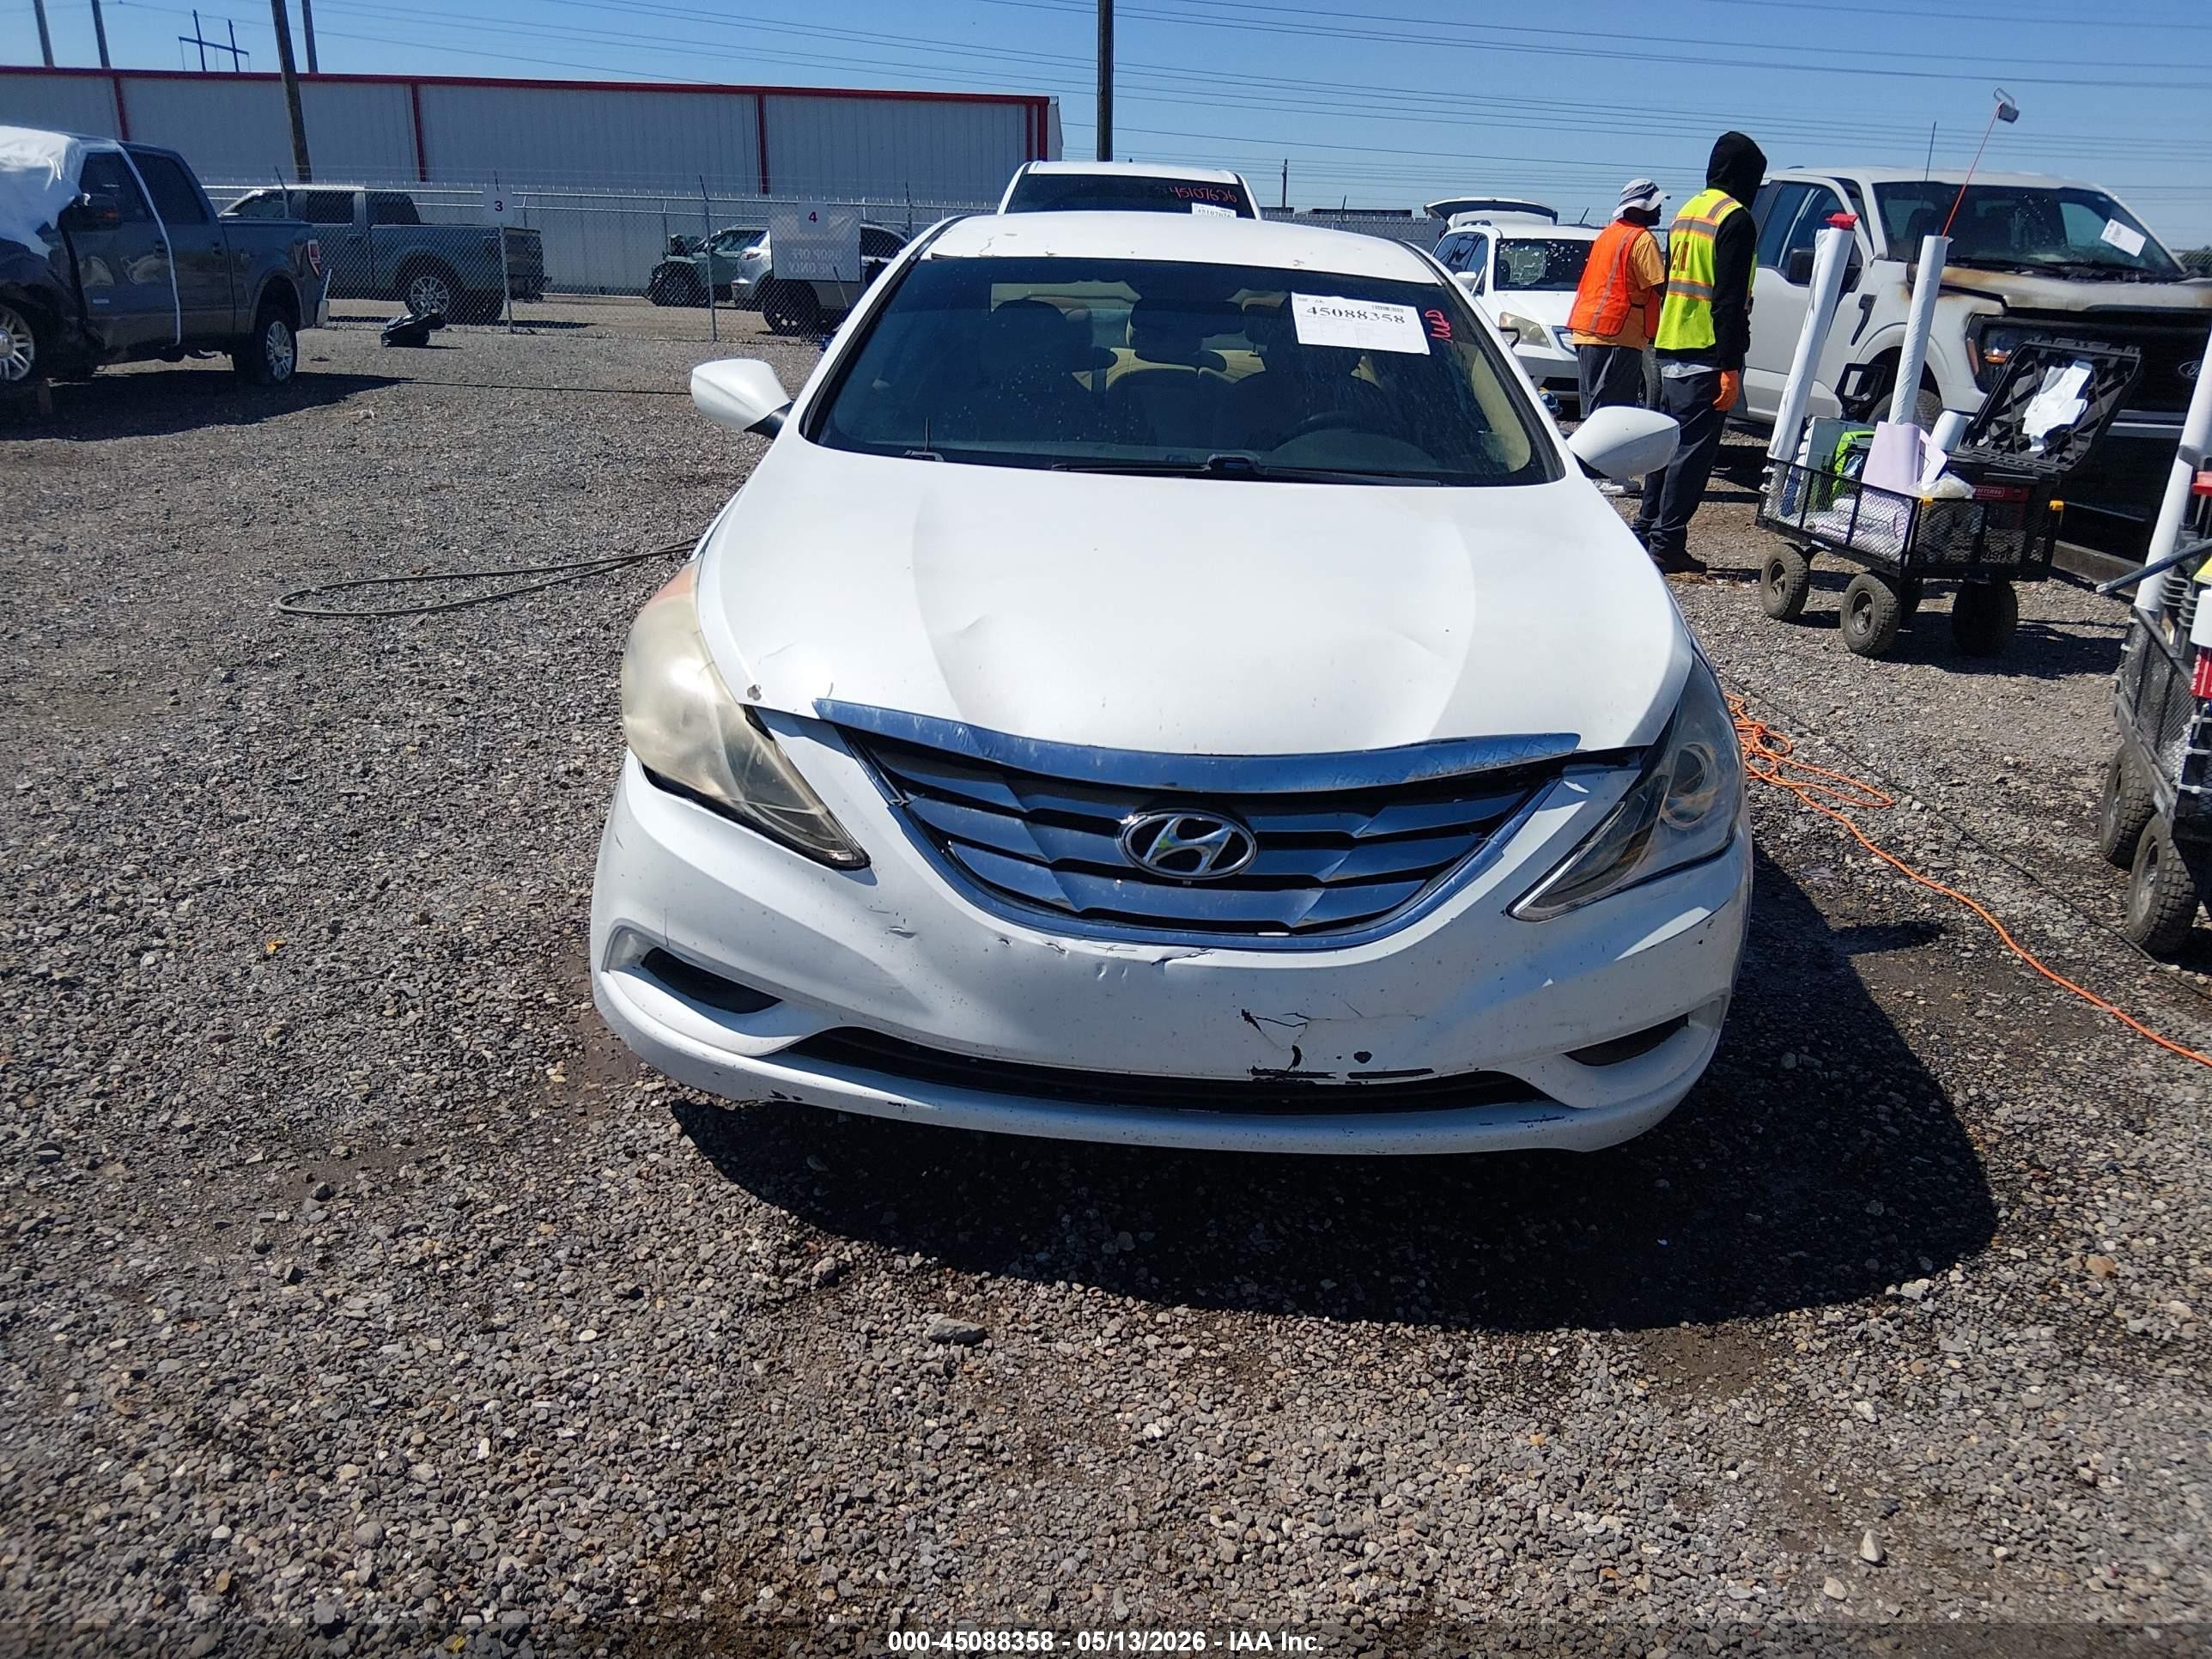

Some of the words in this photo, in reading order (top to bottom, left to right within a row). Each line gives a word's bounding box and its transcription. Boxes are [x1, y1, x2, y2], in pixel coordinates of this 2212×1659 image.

[1169, 186, 1237, 203] 45107626
[495, 201, 503, 211] 3
[808, 211, 817, 223] 4
[1306, 306, 1406, 325] 45088358
